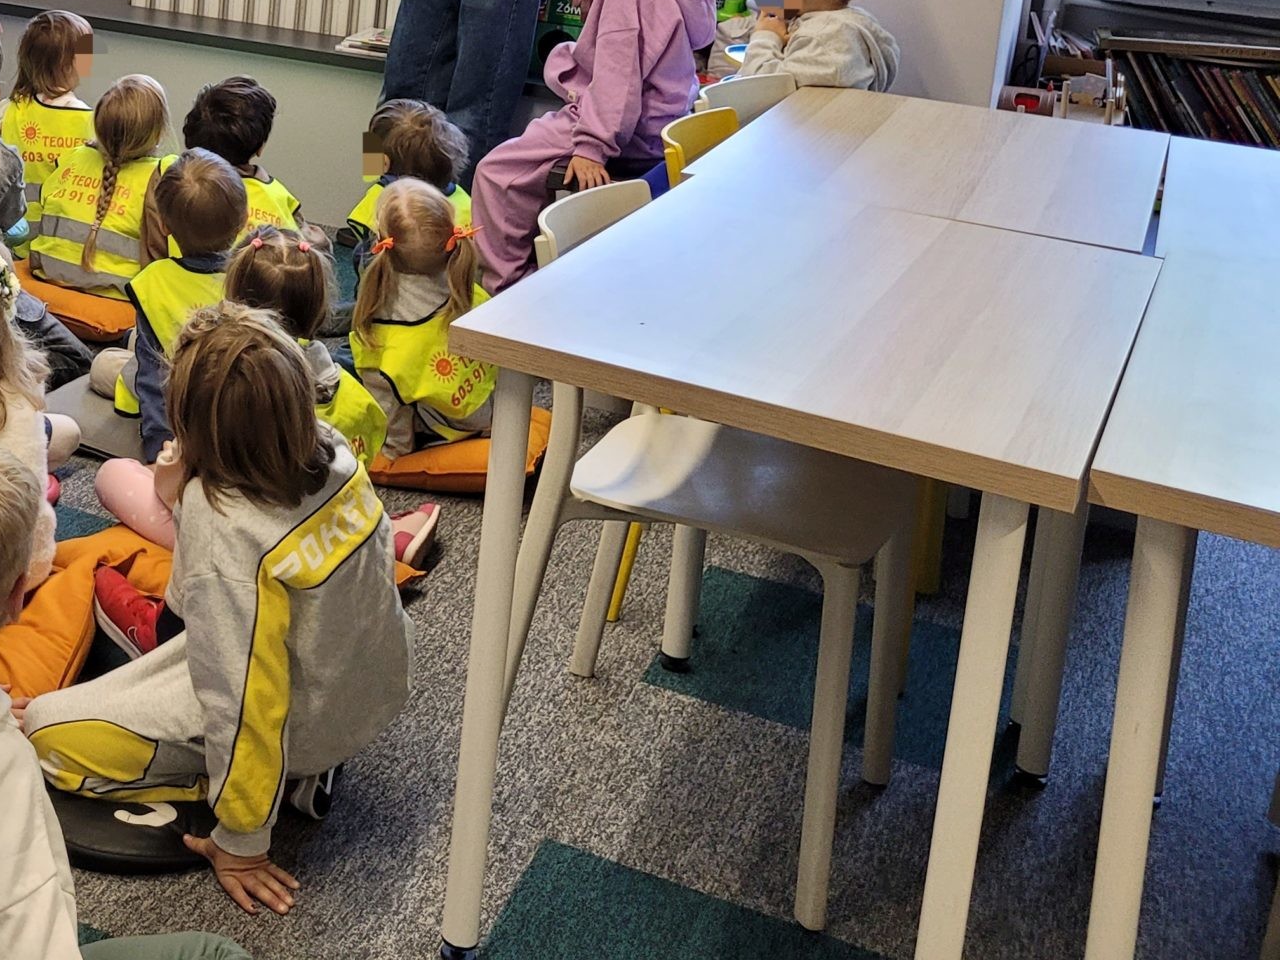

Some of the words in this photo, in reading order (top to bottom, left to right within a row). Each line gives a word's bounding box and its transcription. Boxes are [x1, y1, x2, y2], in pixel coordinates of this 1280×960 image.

[22, 150, 44, 162] 603
[72, 174, 131, 199] TEQUTA
[69, 190, 84, 203] 91
[450, 378, 474, 407] 603
